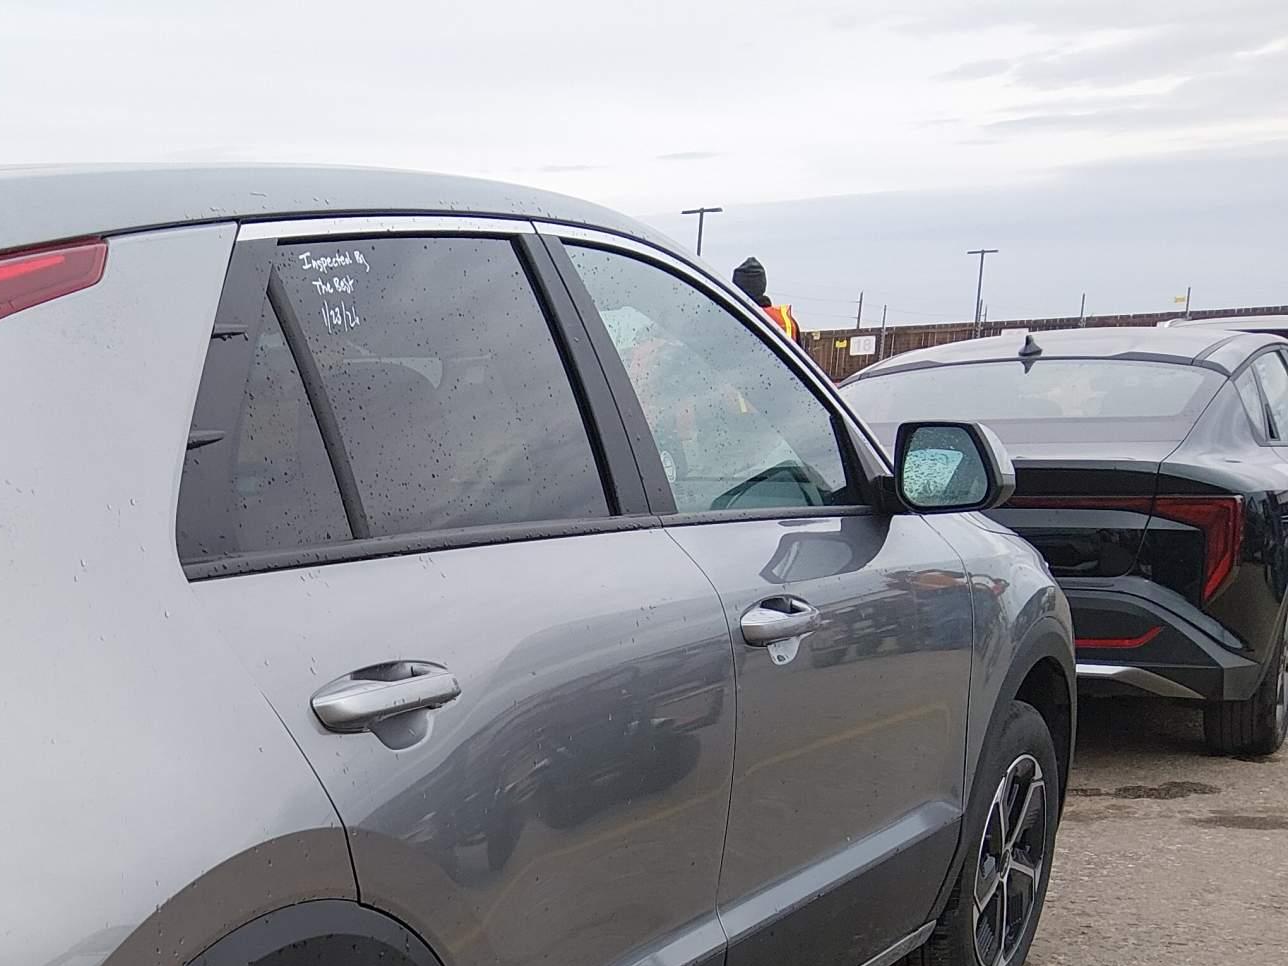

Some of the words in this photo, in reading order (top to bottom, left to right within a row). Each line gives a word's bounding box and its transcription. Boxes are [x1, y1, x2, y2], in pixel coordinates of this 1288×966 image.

[298, 251, 352, 273] Inspected
[312, 277, 333, 296] The
[333, 275, 355, 295] Best
[854, 338, 872, 351] 18
